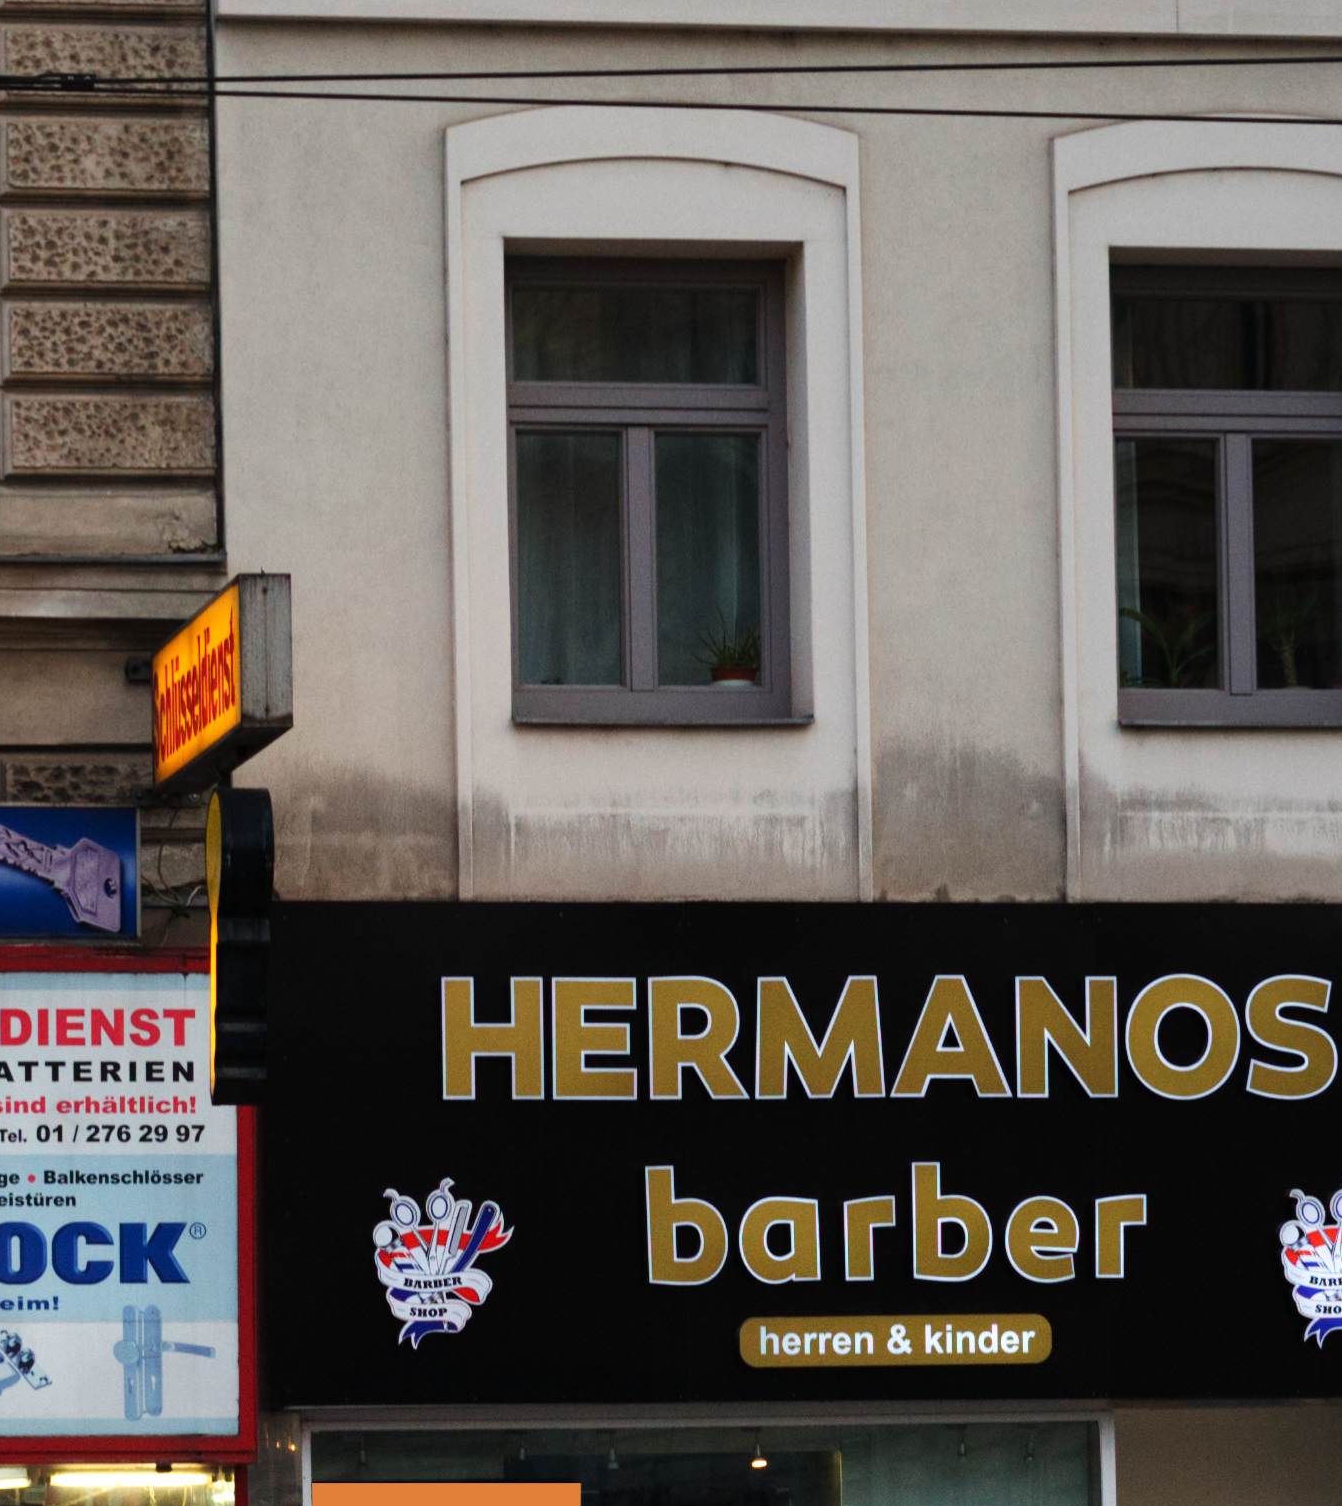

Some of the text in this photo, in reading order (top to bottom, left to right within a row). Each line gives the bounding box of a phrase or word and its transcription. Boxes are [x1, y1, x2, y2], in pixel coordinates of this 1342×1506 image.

[153, 607, 236, 769] Schlüsseldienst
[439, 972, 1340, 1101] HERMANOS
[55, 1095, 197, 1115] erhältlich!
[35, 1124, 64, 1143] 01
[85, 1124, 132, 1143] 276
[138, 1124, 169, 1143] 29
[175, 1124, 206, 1143] 97
[43, 1168, 204, 1186] Balkenschlösser
[643, 1161, 1148, 1285] barber
[403, 1276, 463, 1290] BARBER
[409, 1306, 449, 1318] SHOP
[757, 1323, 1037, 1358] herren & kinder
